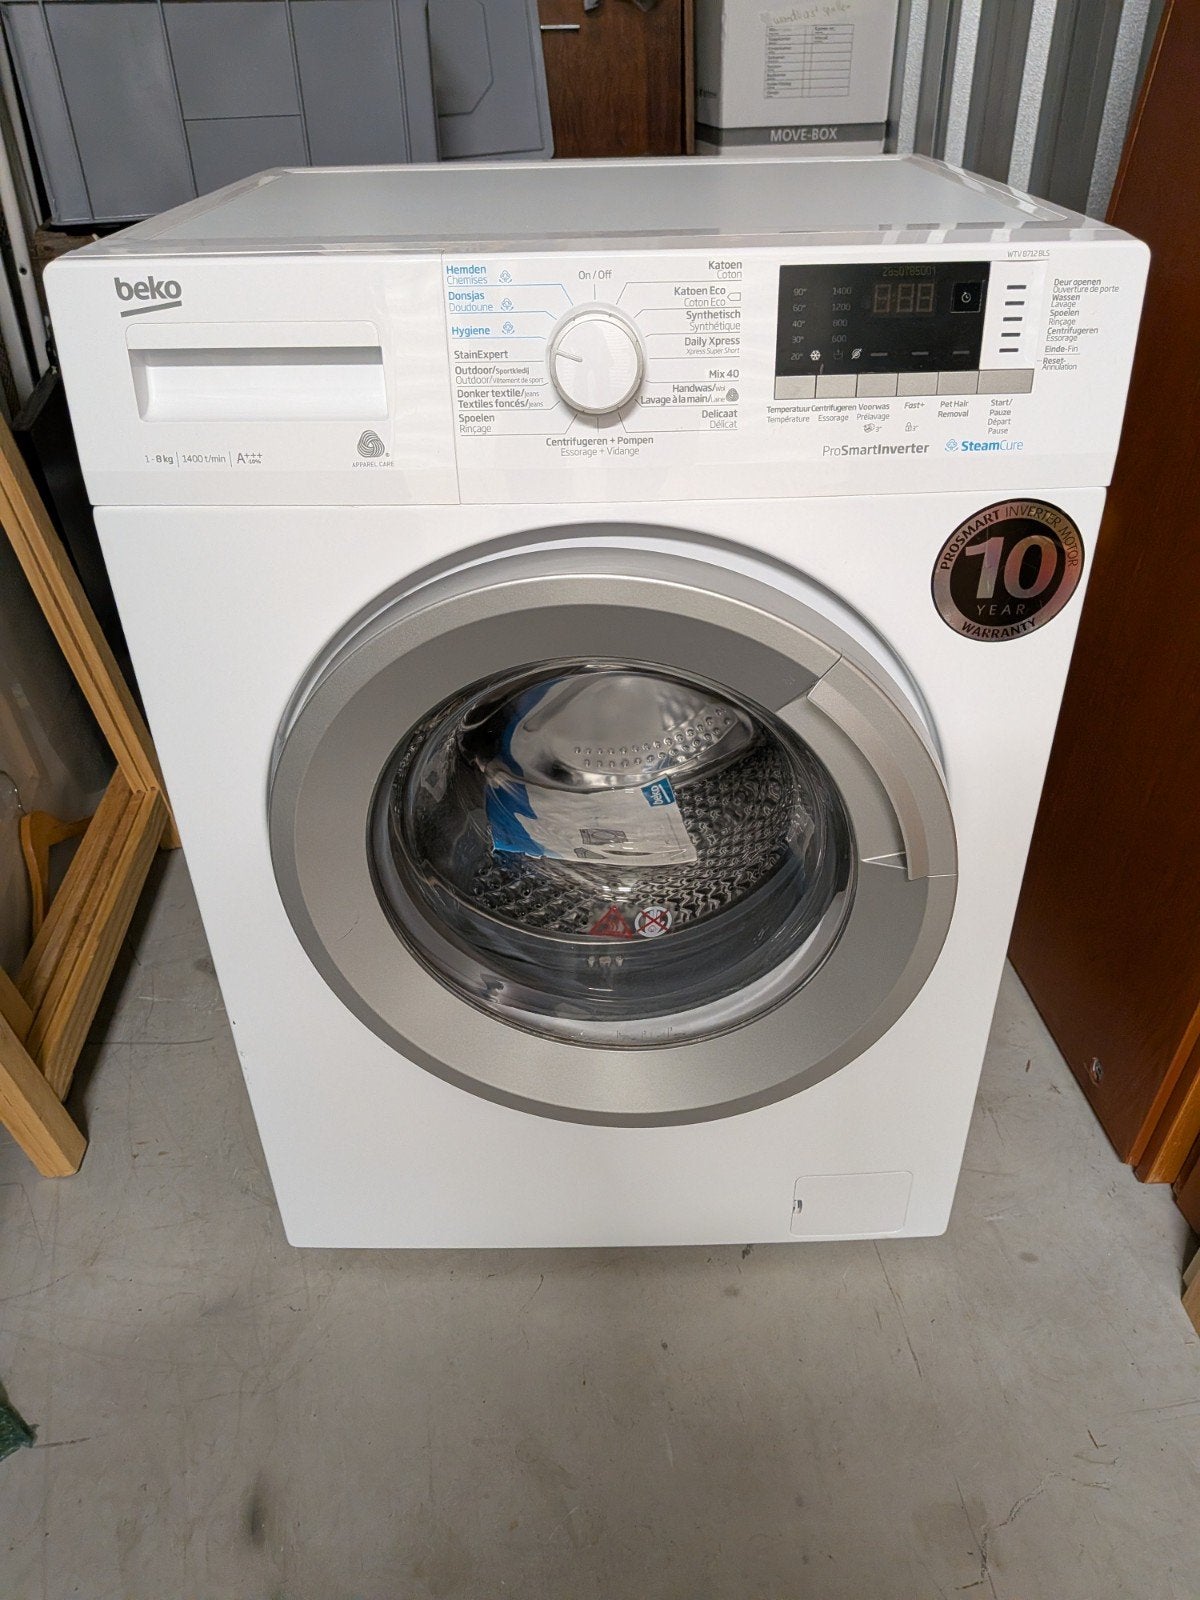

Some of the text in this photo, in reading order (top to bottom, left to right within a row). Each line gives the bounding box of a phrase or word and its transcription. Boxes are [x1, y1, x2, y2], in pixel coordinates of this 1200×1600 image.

[770, 128, 837, 142] MOVE-BOX
[446, 265, 486, 274] Hemden
[709, 261, 742, 269] Katoen
[579, 270, 612, 280] On / Off
[717, 270, 742, 279] Coton
[447, 275, 488, 285] Chemises
[114, 275, 182, 301] beko
[674, 286, 726, 296] Katoen Eco
[794, 288, 807, 296] 90°
[833, 287, 852, 295] 1400
[1053, 285, 1088, 293] Ouverture
[1100, 286, 1119, 294] porte
[448, 292, 485, 302] Donsjas
[449, 303, 493, 311] Doudoune
[684, 298, 726, 307] Coton Eco
[1051, 301, 1076, 310] Lavage
[686, 310, 741, 321] Synthetisch
[1050, 310, 1079, 318] Spoelen
[690, 322, 740, 331] Synthétique
[792, 320, 805, 328] 40°
[1048, 318, 1076, 326] Rinçage
[451, 327, 490, 337] Hygiene
[1047, 327, 1098, 336] Centrifugeren
[684, 337, 740, 348] Daily Xpress
[832, 335, 847, 343] 600
[454, 350, 508, 360] StainExpert
[709, 370, 739, 378] Mix 40
[529, 377, 543, 385] sport
[457, 389, 490, 398] Donker
[458, 400, 494, 409] Textiles
[641, 396, 671, 406] Lavage
[673, 395, 678, 403] à
[679, 395, 686, 403] la
[904, 401, 925, 409] Fast+
[767, 406, 810, 414] Temperatuur
[811, 404, 856, 412] Centrifugeren
[858, 403, 890, 411] Voorwas
[702, 410, 738, 419] Delicaat
[857, 413, 889, 421] Prélavage
[938, 410, 969, 418] Removal
[459, 414, 495, 424] Spoelen
[767, 414, 810, 424] Température
[988, 418, 1011, 426] Départ
[460, 424, 491, 434] Rinçage
[710, 420, 737, 429] Délicat
[546, 436, 608, 448] Centrifugeren
[617, 437, 653, 446] Pompen
[961, 440, 1023, 451] SteamCure
[561, 448, 597, 458] Essorage
[607, 448, 639, 457] Vidange
[823, 444, 929, 456] ProSmartInverter
[163, 455, 174, 464] kg
[182, 455, 203, 463] 1400
[940, 504, 1079, 570] PROSMART INVERTER MOTOR
[966, 535, 1057, 599] 10
[977, 604, 1025, 615] YEAR
[962, 618, 1037, 639] WARRANTY
[650, 785, 664, 805] beko
